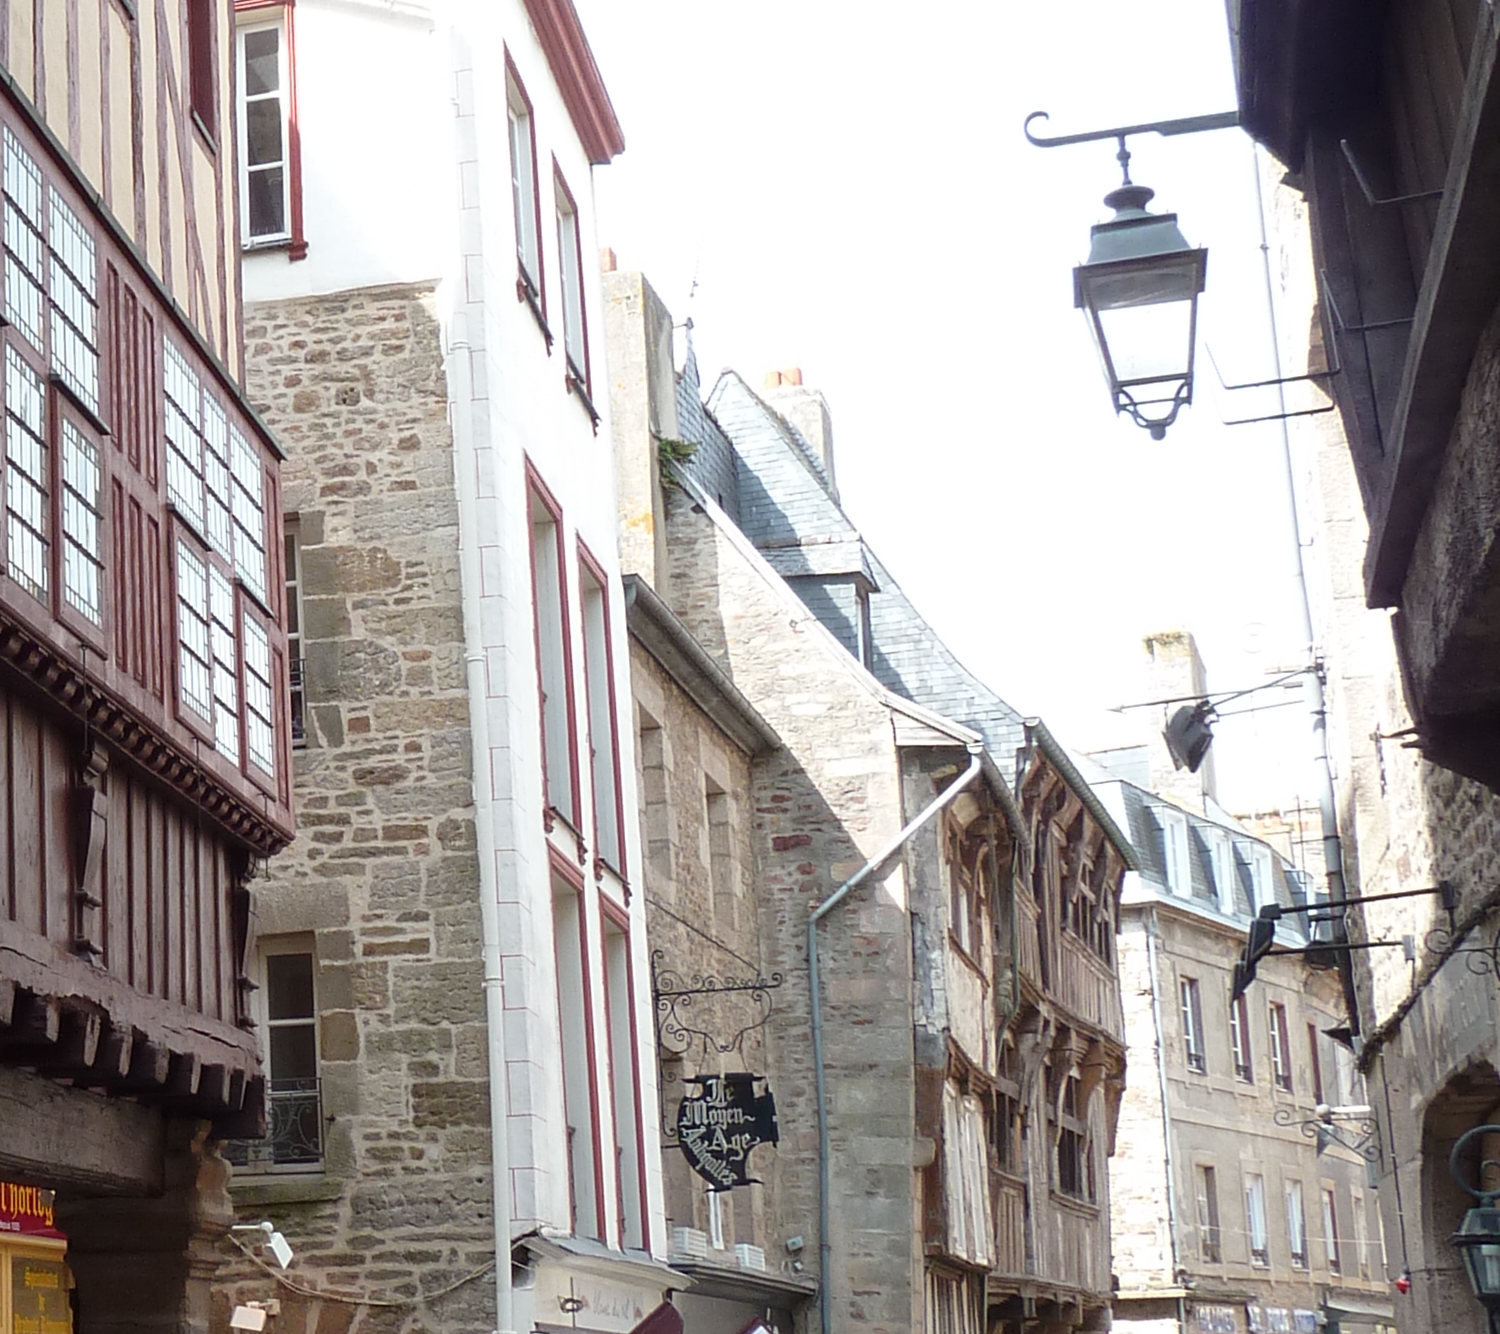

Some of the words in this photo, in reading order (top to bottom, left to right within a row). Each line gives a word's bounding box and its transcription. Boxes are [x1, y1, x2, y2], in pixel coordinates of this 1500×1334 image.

[705, 1078, 734, 1107] Le
[679, 1100, 750, 1130] Moyen
[704, 1126, 760, 1161] Age
